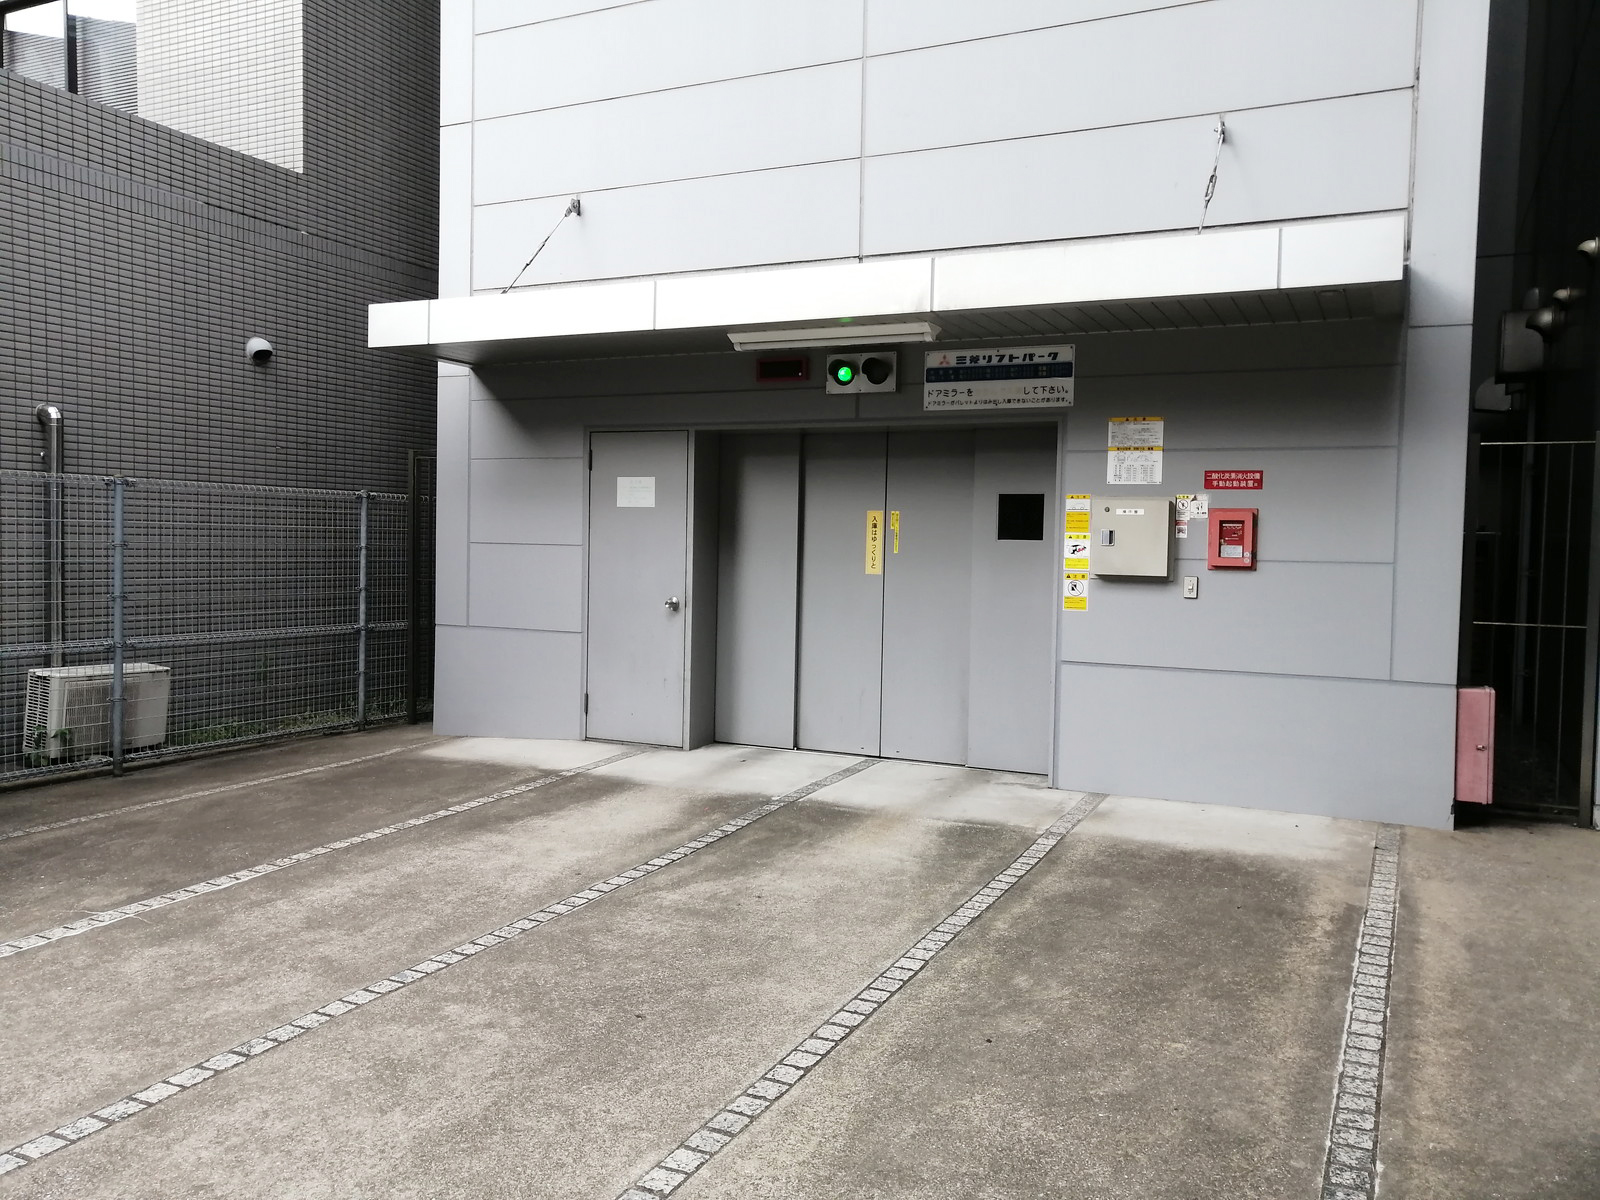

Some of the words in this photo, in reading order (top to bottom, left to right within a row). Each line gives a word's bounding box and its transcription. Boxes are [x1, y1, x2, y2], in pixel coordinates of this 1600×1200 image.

[955, 352, 1059, 365] 三菱リフトパーク
[927, 388, 974, 398] ドアミラーを
[1023, 385, 1069, 396] して下さい。
